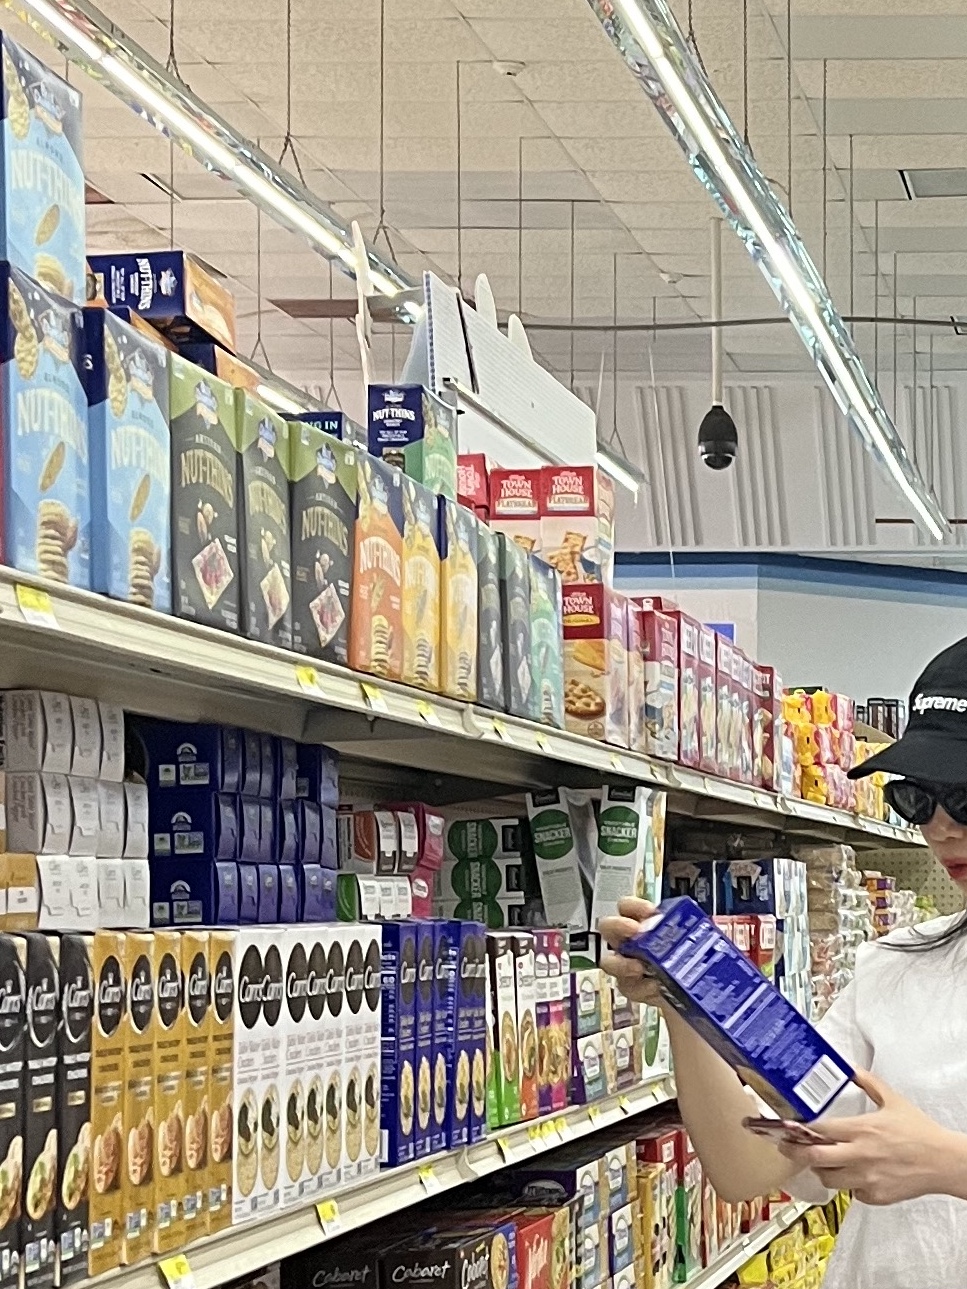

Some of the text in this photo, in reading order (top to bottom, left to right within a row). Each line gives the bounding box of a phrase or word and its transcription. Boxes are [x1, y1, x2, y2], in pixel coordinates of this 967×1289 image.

[501, 479, 532, 491] TOWN
[552, 475, 583, 487] TOWN
[501, 488, 533, 498] HOUSE
[552, 484, 585, 495] HOUSE
[563, 596, 593, 606] TOWN
[563, 604, 594, 614] HOUSE
[601, 825, 637, 838] SNACKER
[312, 1265, 373, 1289] Cabaret
[392, 1260, 451, 1284] Cabaret
